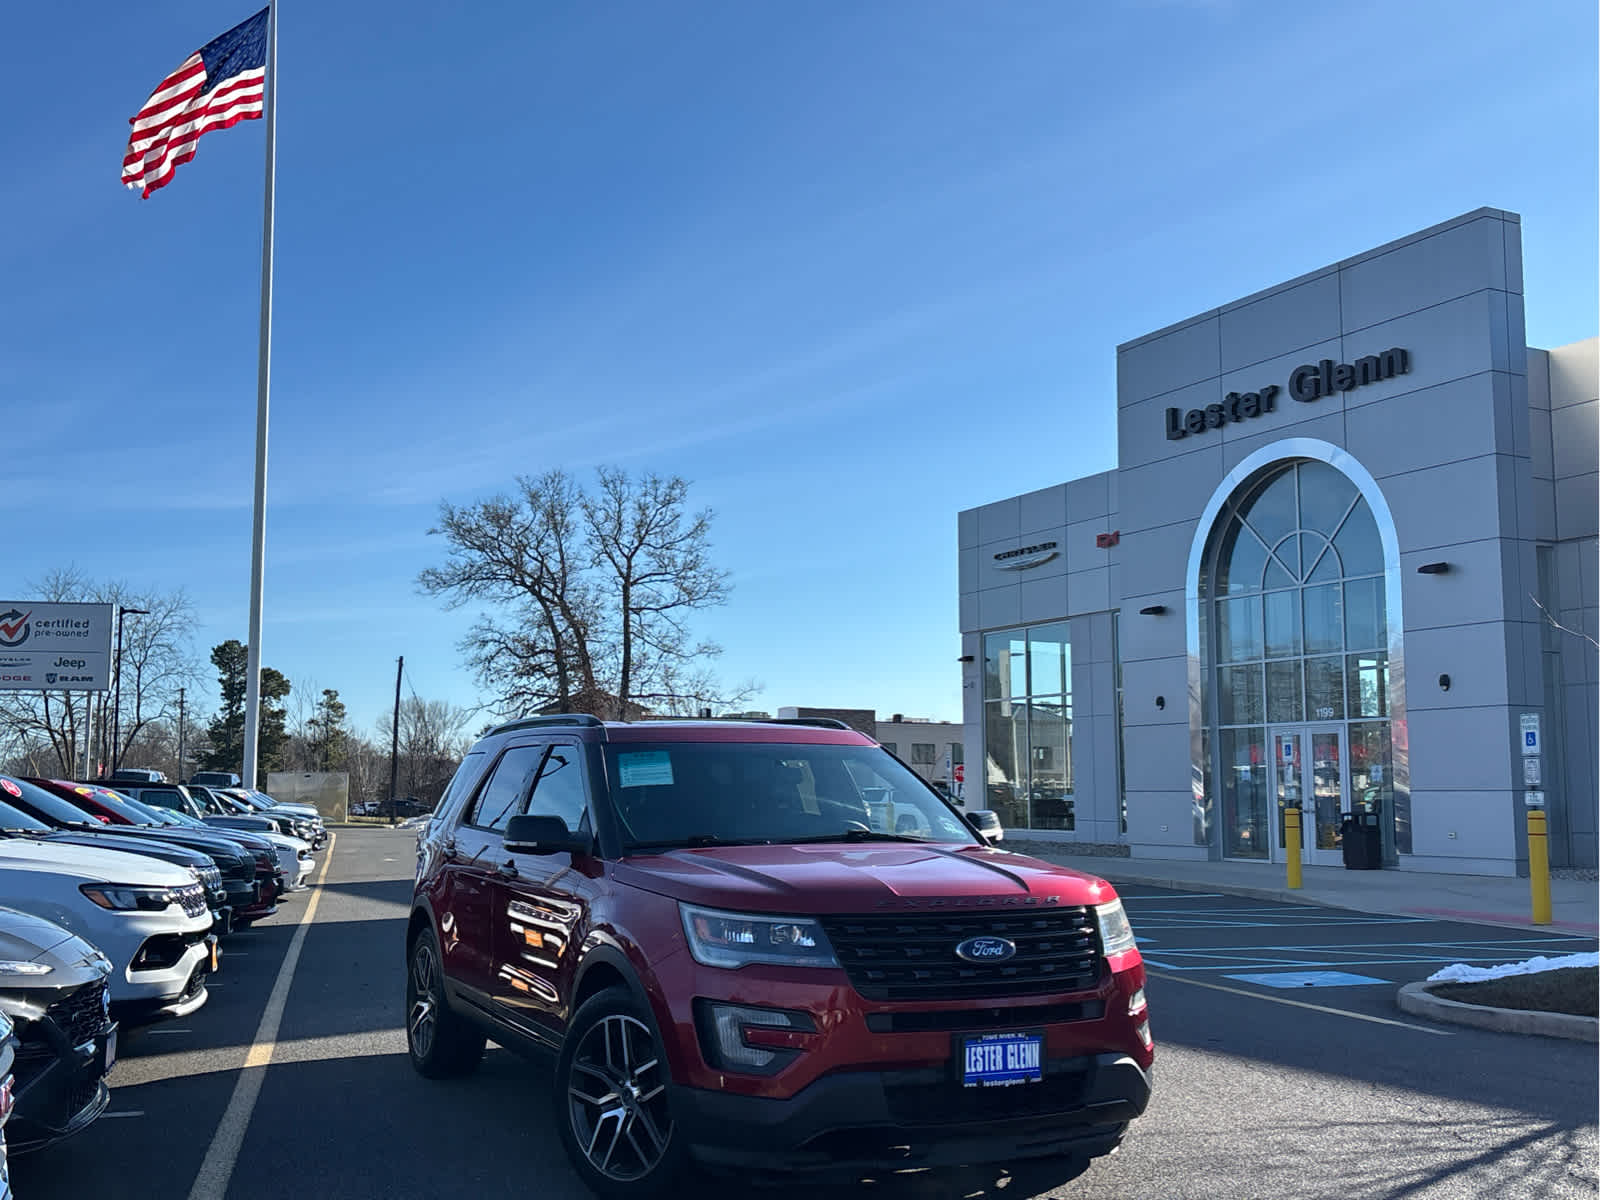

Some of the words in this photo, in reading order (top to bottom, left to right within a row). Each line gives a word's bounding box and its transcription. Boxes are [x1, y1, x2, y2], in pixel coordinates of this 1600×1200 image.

[1166, 384, 1280, 440] Lester
[1289, 346, 1410, 402] Glenn
[35, 619, 90, 628] certified
[34, 630, 89, 638] pre-owned
[53, 657, 86, 669] Jeep
[1316, 707, 1334, 717] 1199
[875, 895, 1061, 906] EXPLORER
[972, 940, 1004, 956] Ford
[965, 1045, 1003, 1073] LESTER
[1007, 1042, 1040, 1070] GLENN
